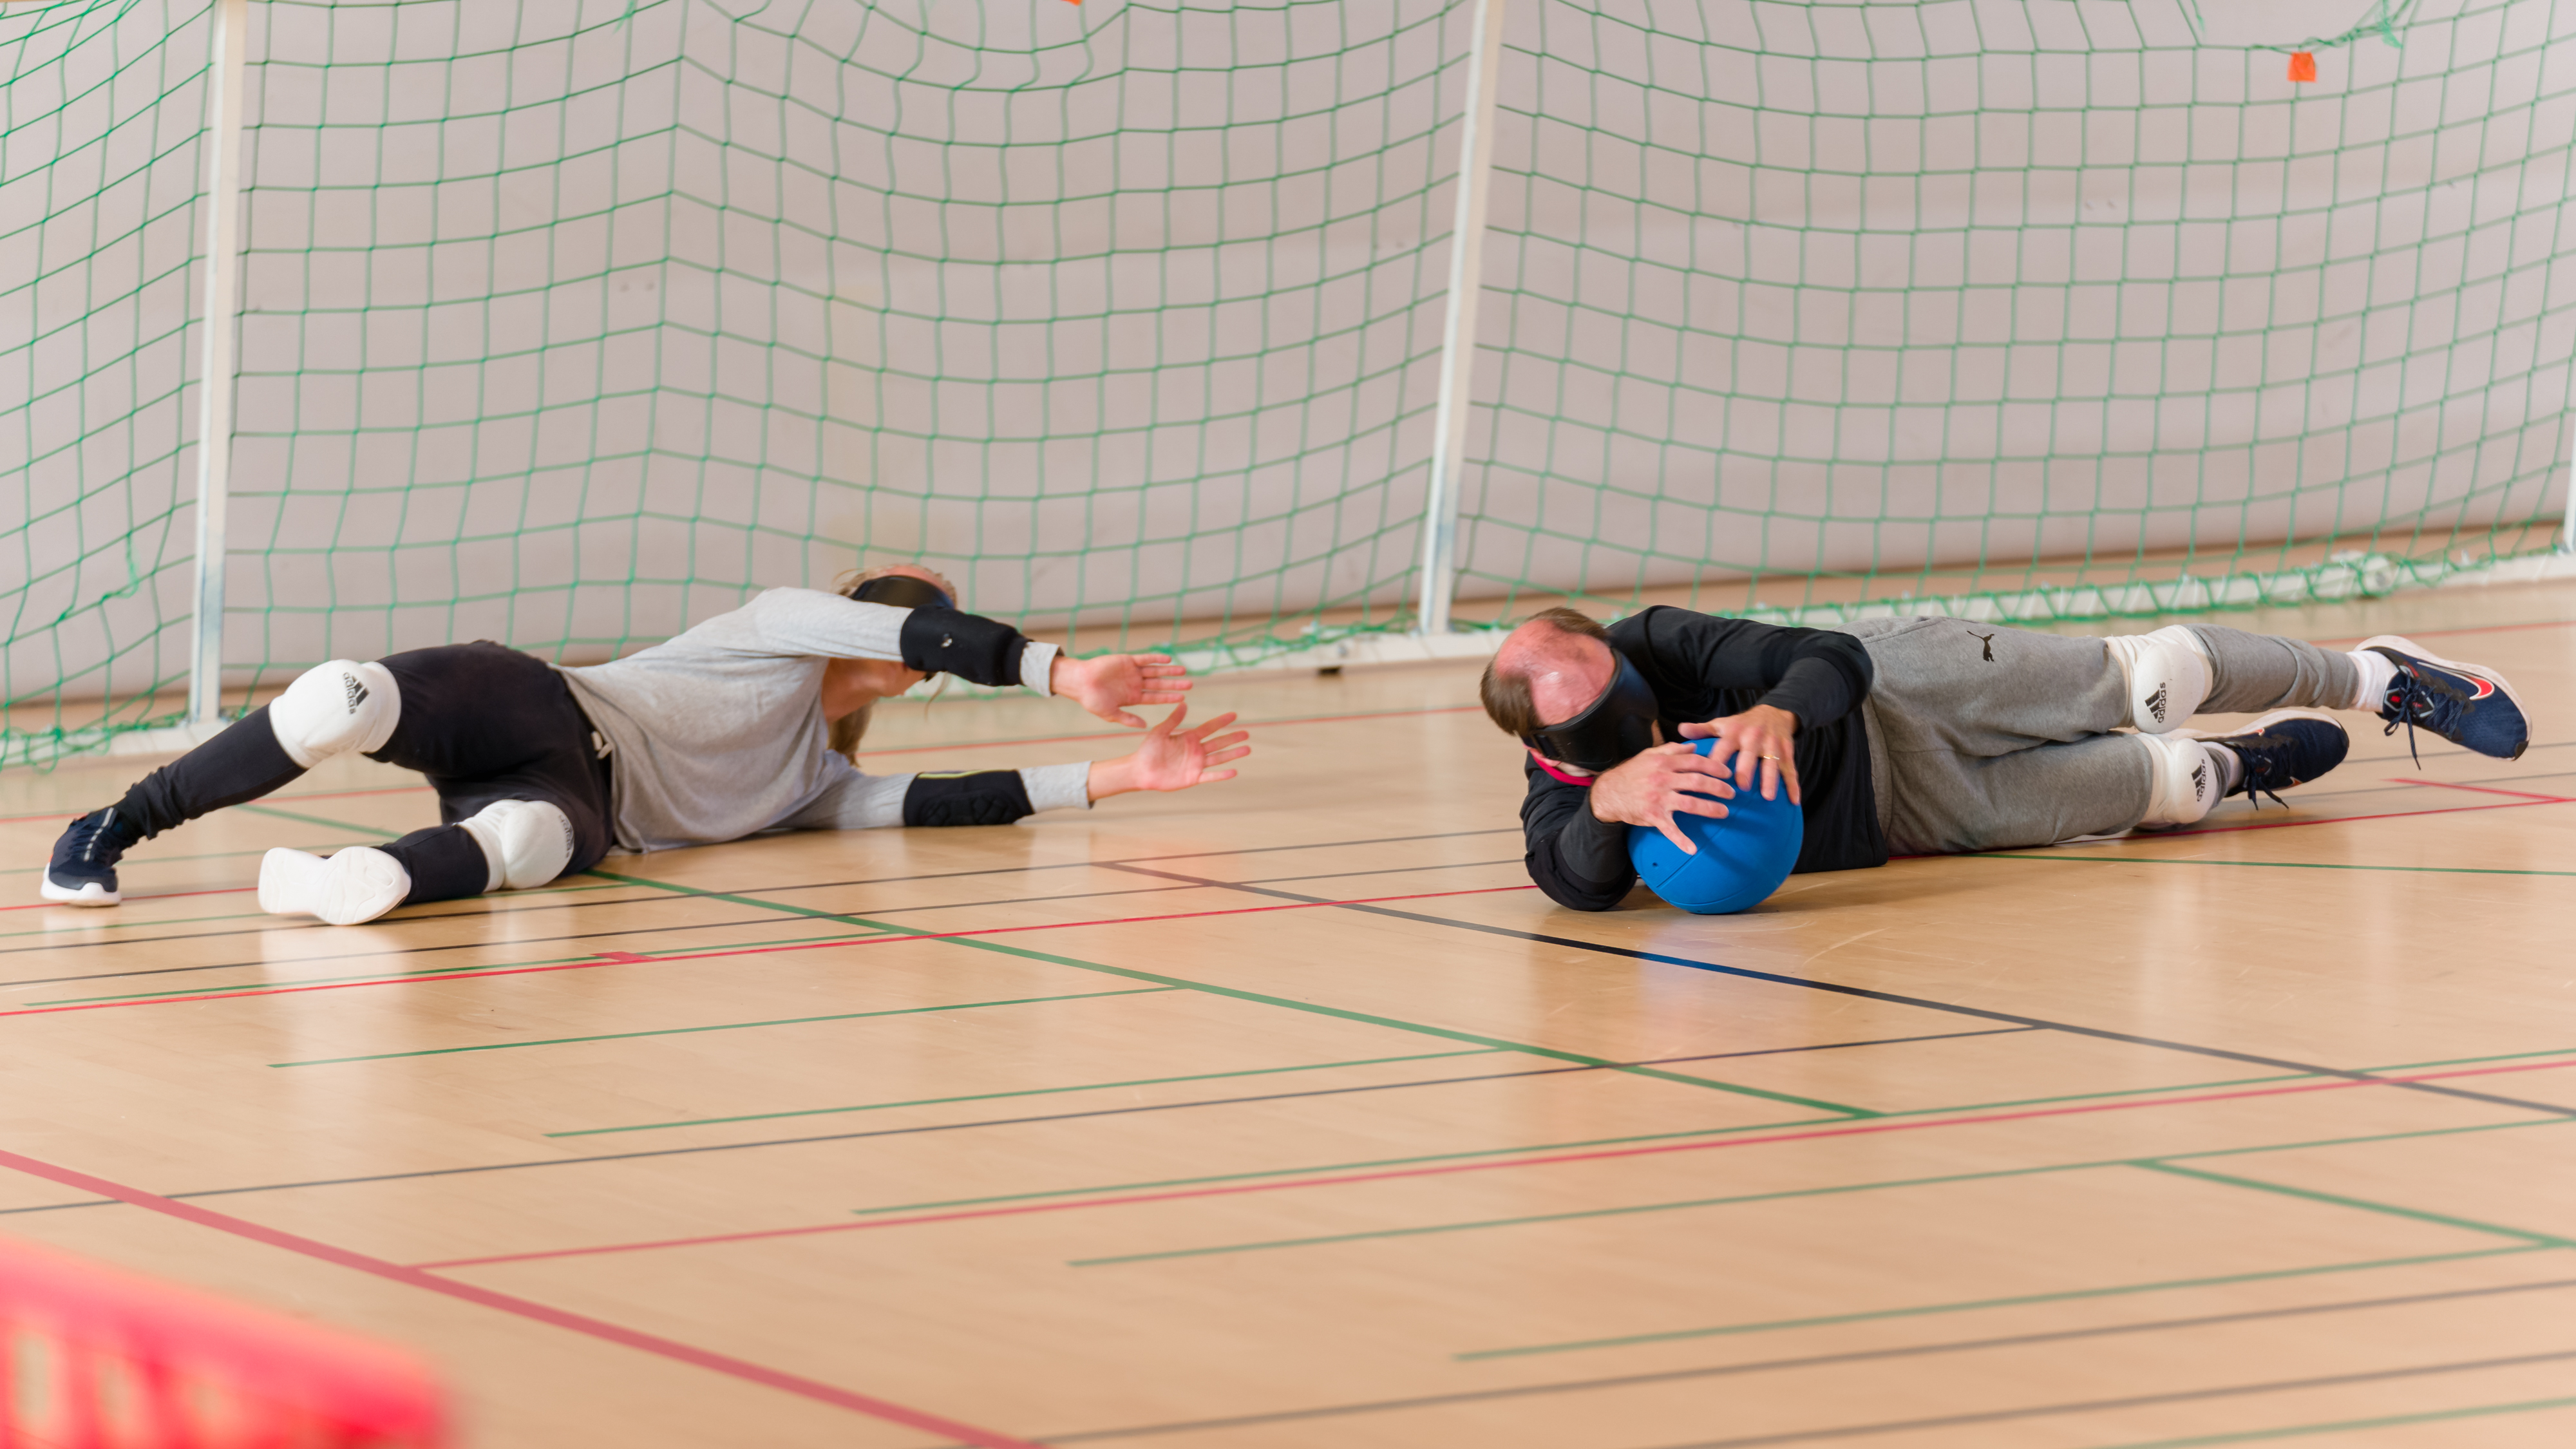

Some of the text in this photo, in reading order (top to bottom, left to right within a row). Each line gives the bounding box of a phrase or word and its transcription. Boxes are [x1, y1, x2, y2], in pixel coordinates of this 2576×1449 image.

[343, 672, 357, 714] adidas
[2157, 681, 2166, 723] adidas
[2197, 758, 2206, 802] adidas
